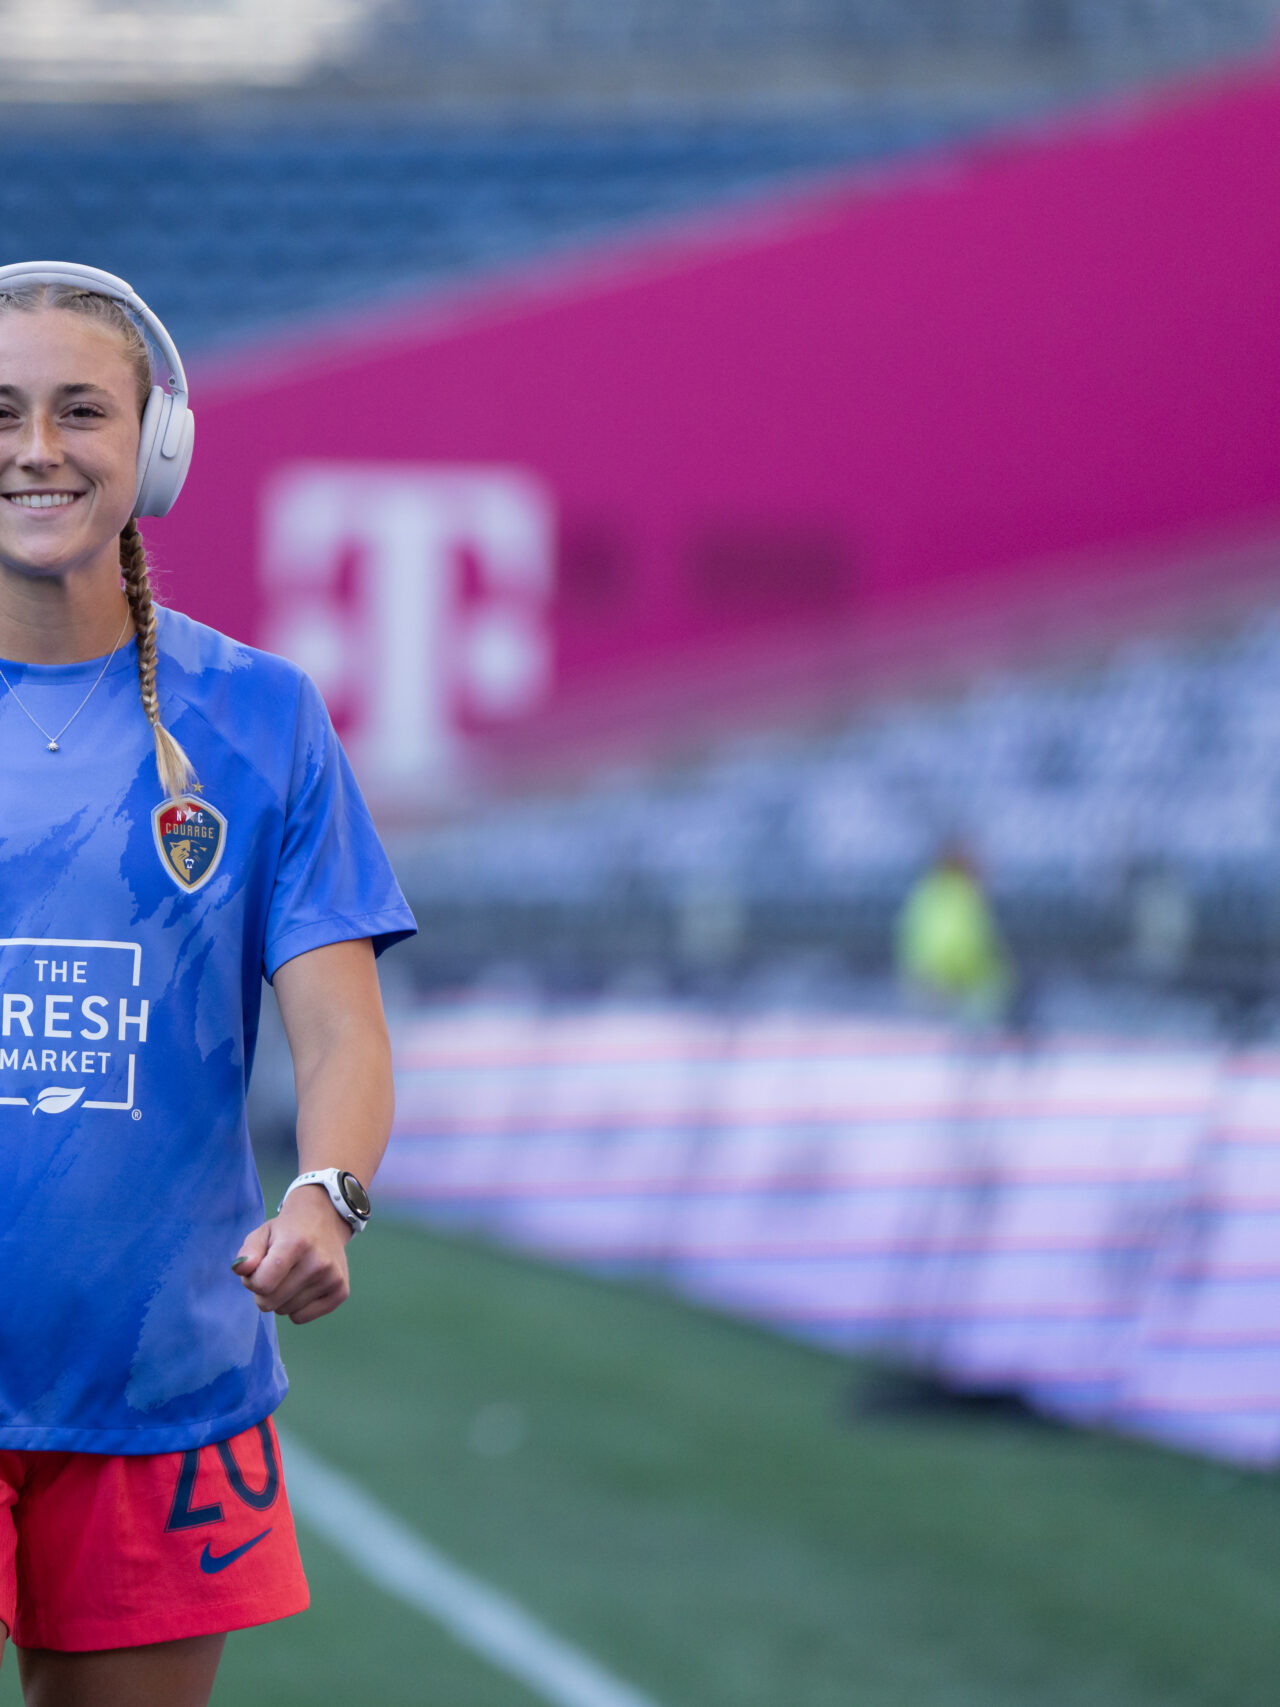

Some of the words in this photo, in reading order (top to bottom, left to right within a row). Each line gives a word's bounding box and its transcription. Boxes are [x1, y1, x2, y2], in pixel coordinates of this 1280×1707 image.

[165, 822, 214, 839] COURAGE
[34, 960, 87, 983] THE
[0, 1048, 111, 1074] MARKET
